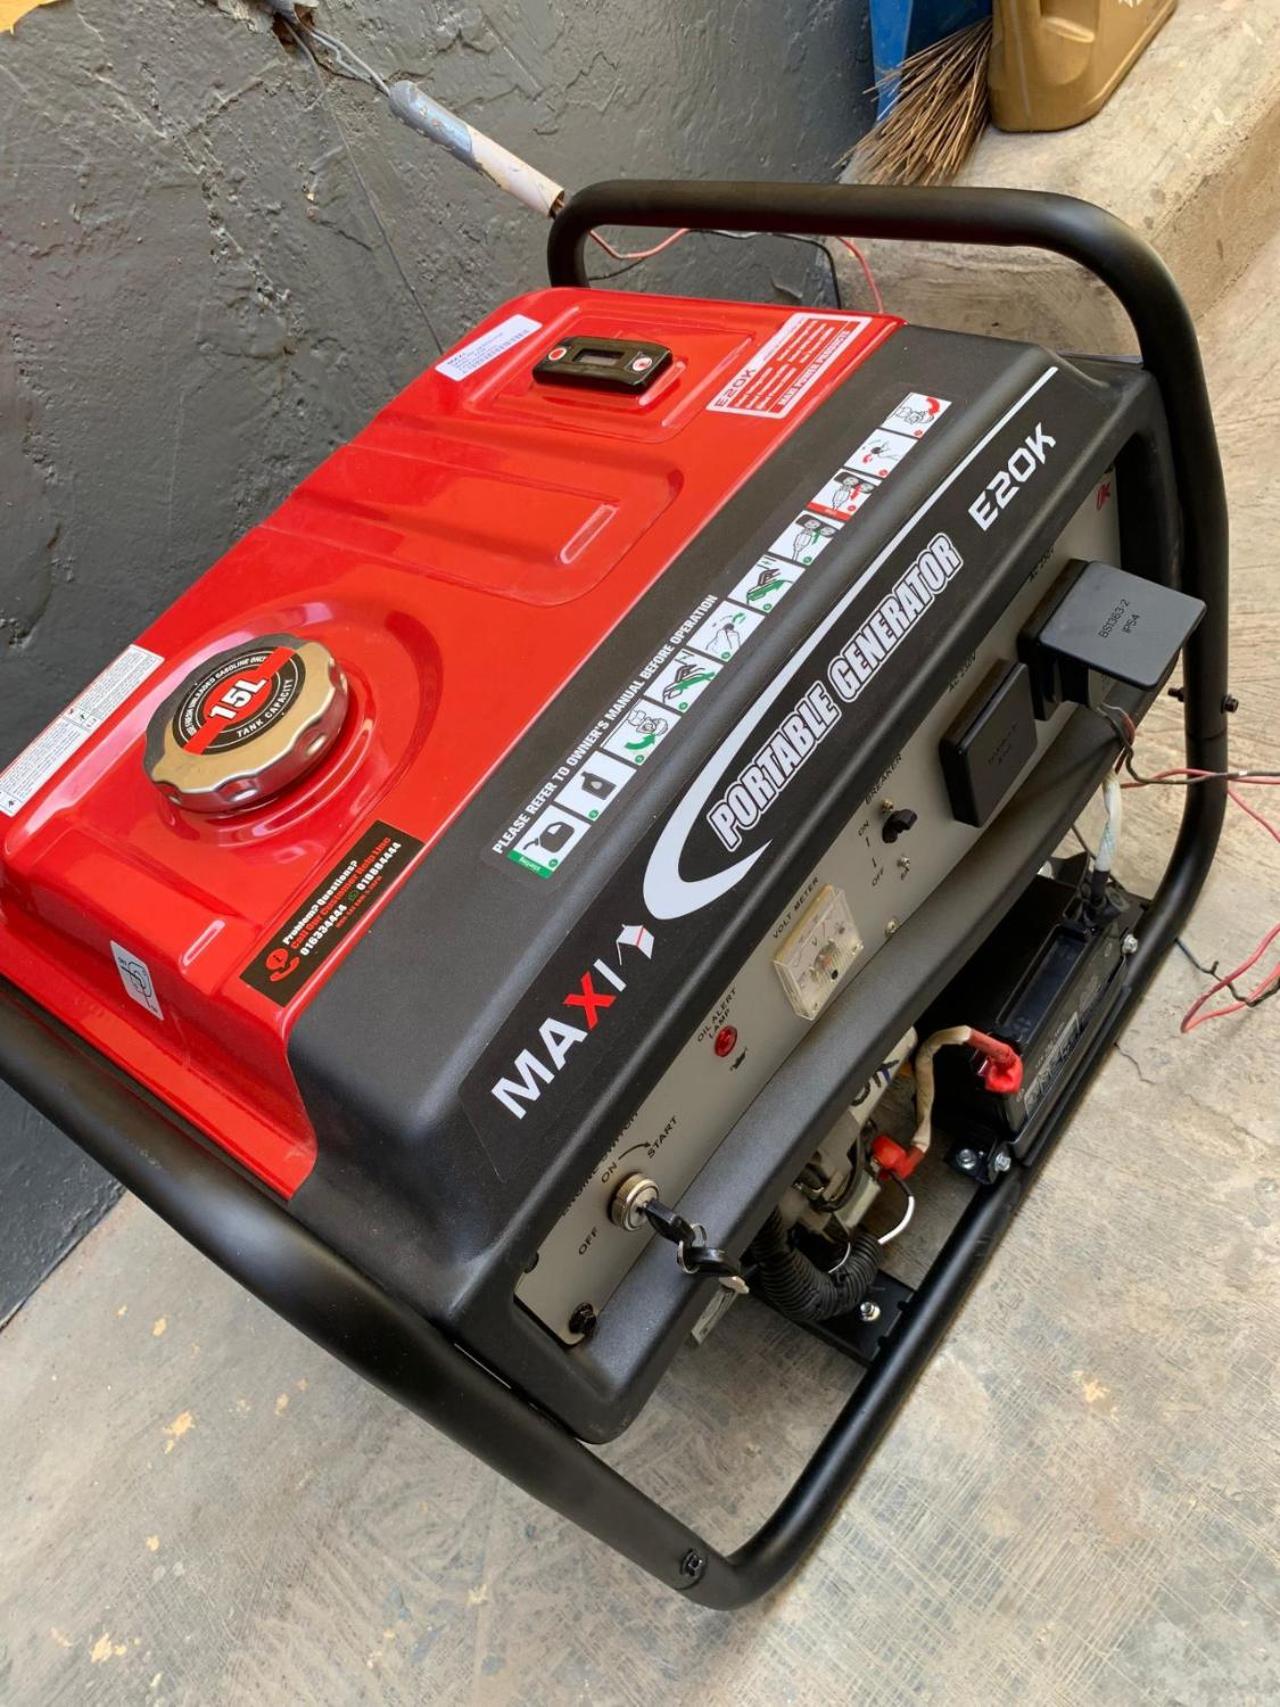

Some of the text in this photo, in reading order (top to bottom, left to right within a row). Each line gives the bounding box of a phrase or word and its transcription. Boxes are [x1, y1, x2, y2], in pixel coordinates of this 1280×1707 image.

[714, 368, 756, 407] E20K
[967, 422, 1056, 531] E20K
[209, 679, 267, 719] 15L
[237, 679, 294, 738] TANK CAPACITY
[706, 532, 964, 851] PORTABLE GENERATOR
[492, 814, 531, 854] PLEASE
[528, 782, 558, 816] REFER
[552, 766, 570, 784] TO
[566, 718, 609, 767] OWNER'S
[604, 679, 646, 725] MANUAL
[641, 643, 675, 680] BEFORE
[669, 594, 719, 646] OPERATION
[858, 820, 869, 836] ON
[872, 867, 884, 886] OFF
[282, 860, 358, 945] Problem? Questions?
[772, 914, 793, 939] VOLT
[794, 877, 819, 911] METER
[491, 958, 627, 1120] MAXI
[697, 988, 737, 1042] OIL ALERT
[708, 1008, 730, 1039] LAMP
[648, 1115, 677, 1159] START
[601, 1162, 617, 1184] ON
[578, 1227, 598, 1256] OFF
